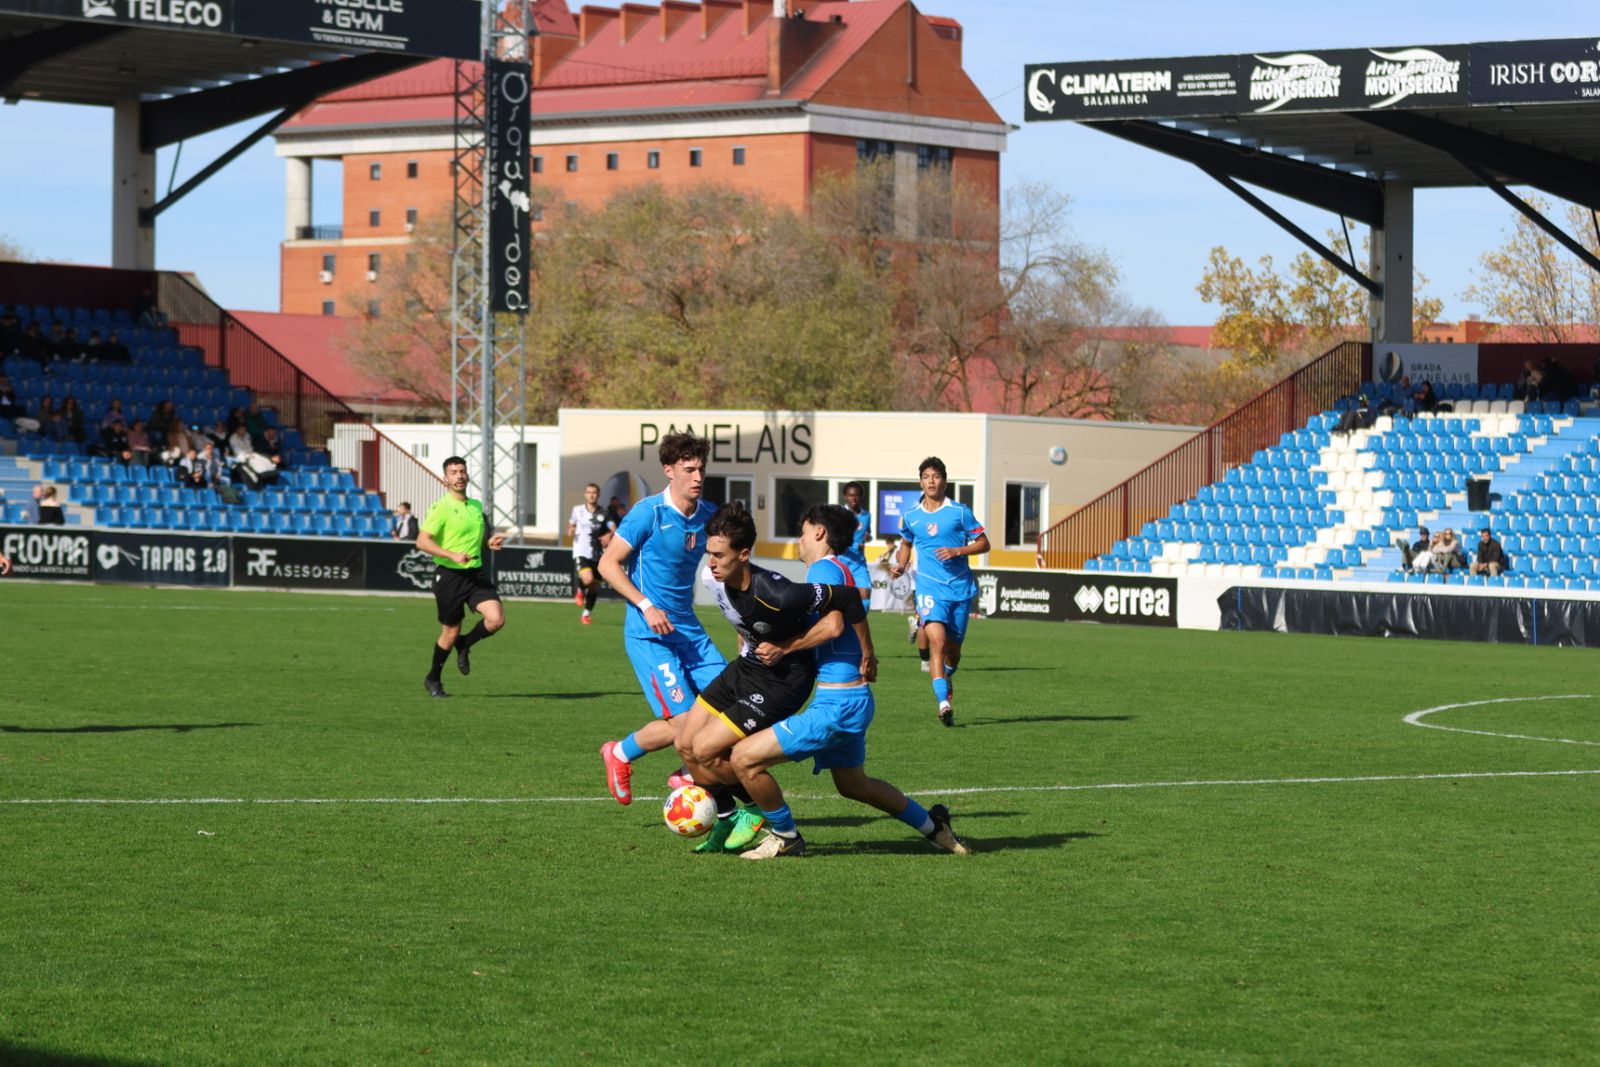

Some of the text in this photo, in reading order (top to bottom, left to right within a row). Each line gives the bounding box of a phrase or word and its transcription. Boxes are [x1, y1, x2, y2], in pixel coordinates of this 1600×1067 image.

[128, 0, 222, 27] TELECO
[314, 0, 404, 13] SCLE
[322, 8, 383, 31] & GYM
[1251, 65, 1285, 80] Artes
[1366, 60, 1401, 75] Artes
[1489, 61, 1600, 86] IRISH COR
[1061, 71, 1171, 95] CLIMATERM
[1250, 77, 1341, 100] MONTSERRAT
[1365, 74, 1459, 95] MONTSERRAT
[1083, 94, 1148, 106] SALAMANCA
[640, 423, 812, 465] PELAIS
[140, 546, 227, 573] TAPAS 2.0
[273, 564, 350, 580] ASESORES
[497, 571, 571, 583] PAVIMENTOS
[1001, 586, 1050, 600] Ayuntamiento
[1103, 585, 1170, 616] errea
[1001, 600, 1050, 614] de Salamanca
[657, 662, 677, 687] 3
